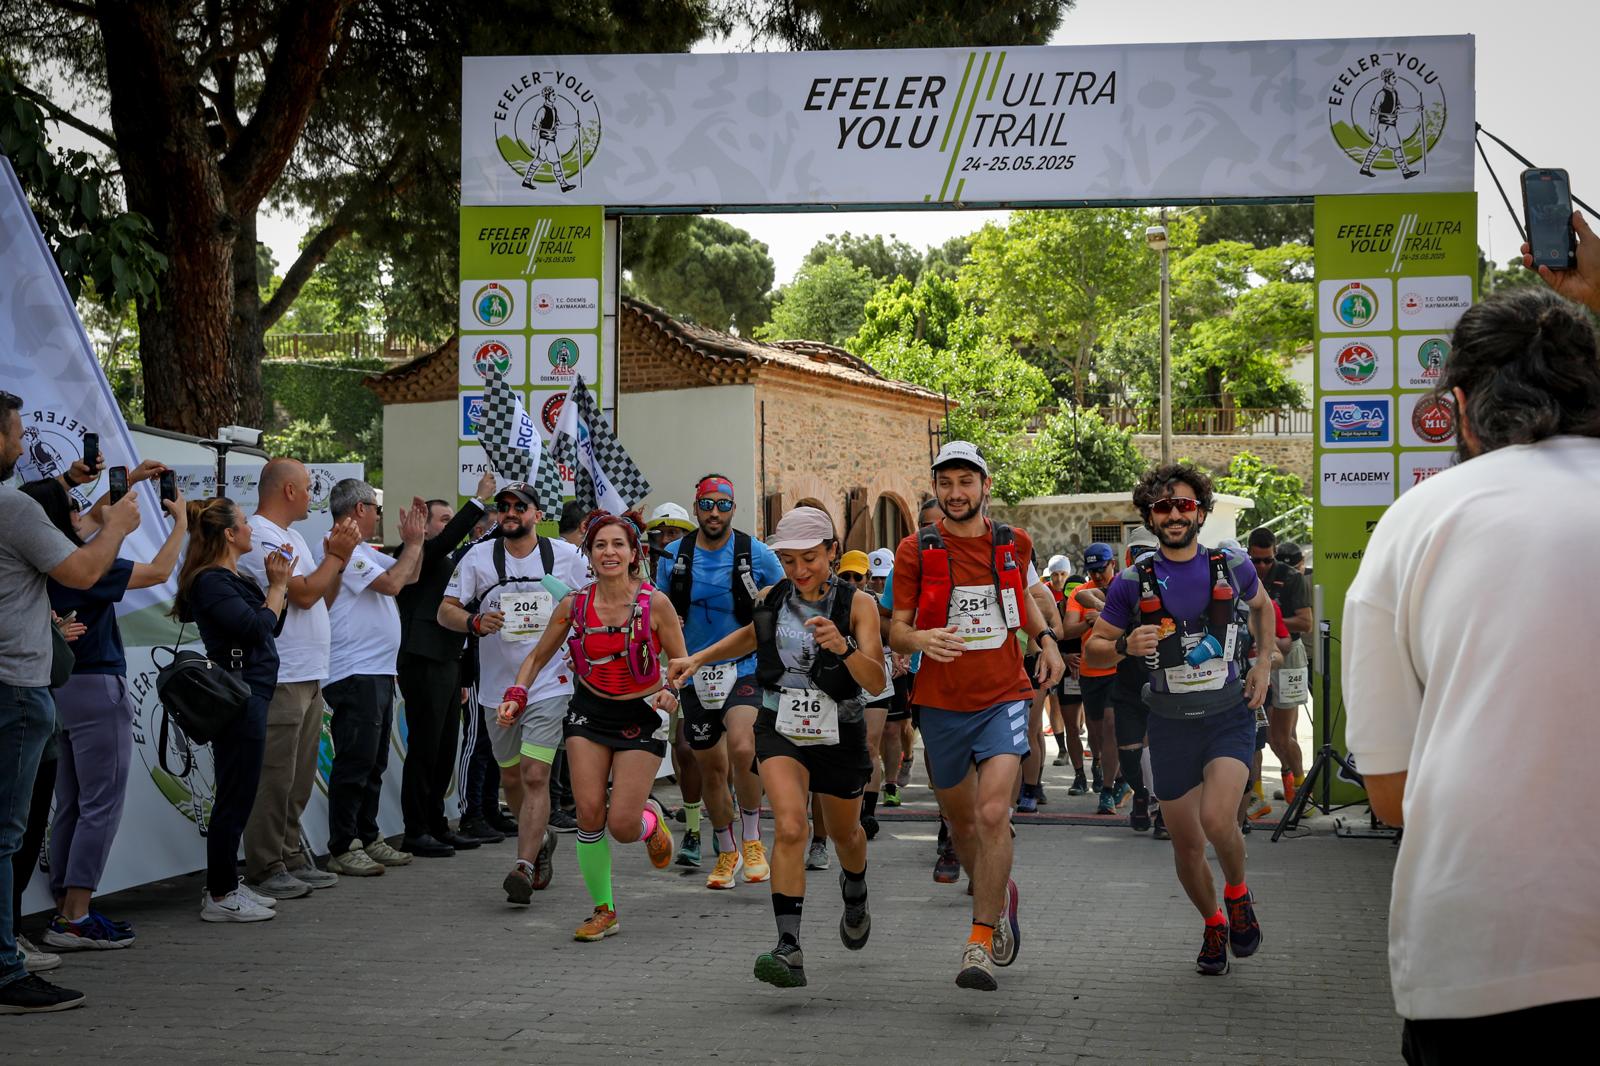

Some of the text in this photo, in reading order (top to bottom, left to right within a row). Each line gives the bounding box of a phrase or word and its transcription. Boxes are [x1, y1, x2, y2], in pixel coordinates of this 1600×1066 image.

[1328, 52, 1438, 105] EFELER YOLU
[494, 71, 594, 120] EFELER YOLU
[803, 75, 946, 111] EFELER
[1001, 70, 1117, 107] ULTRA
[837, 115, 939, 150] YOLU
[971, 112, 1068, 148] TRAIL
[961, 154, 1076, 172] 24-25.05.2025
[478, 227, 530, 241] EFELER
[549, 226, 591, 240] ULTRA
[1337, 224, 1394, 239] EFELER
[1415, 221, 1462, 236] ULTRA
[489, 241, 526, 255] YOLU
[538, 241, 573, 255] TRAIL
[1350, 239, 1391, 254] YOLU
[1404, 237, 1442, 251] TRAIL
[535, 256, 576, 264] 24-25.05.2025
[514, 601, 538, 612] 204
[959, 598, 988, 611] 251
[701, 671, 724, 681] 202
[791, 700, 821, 713] 216
